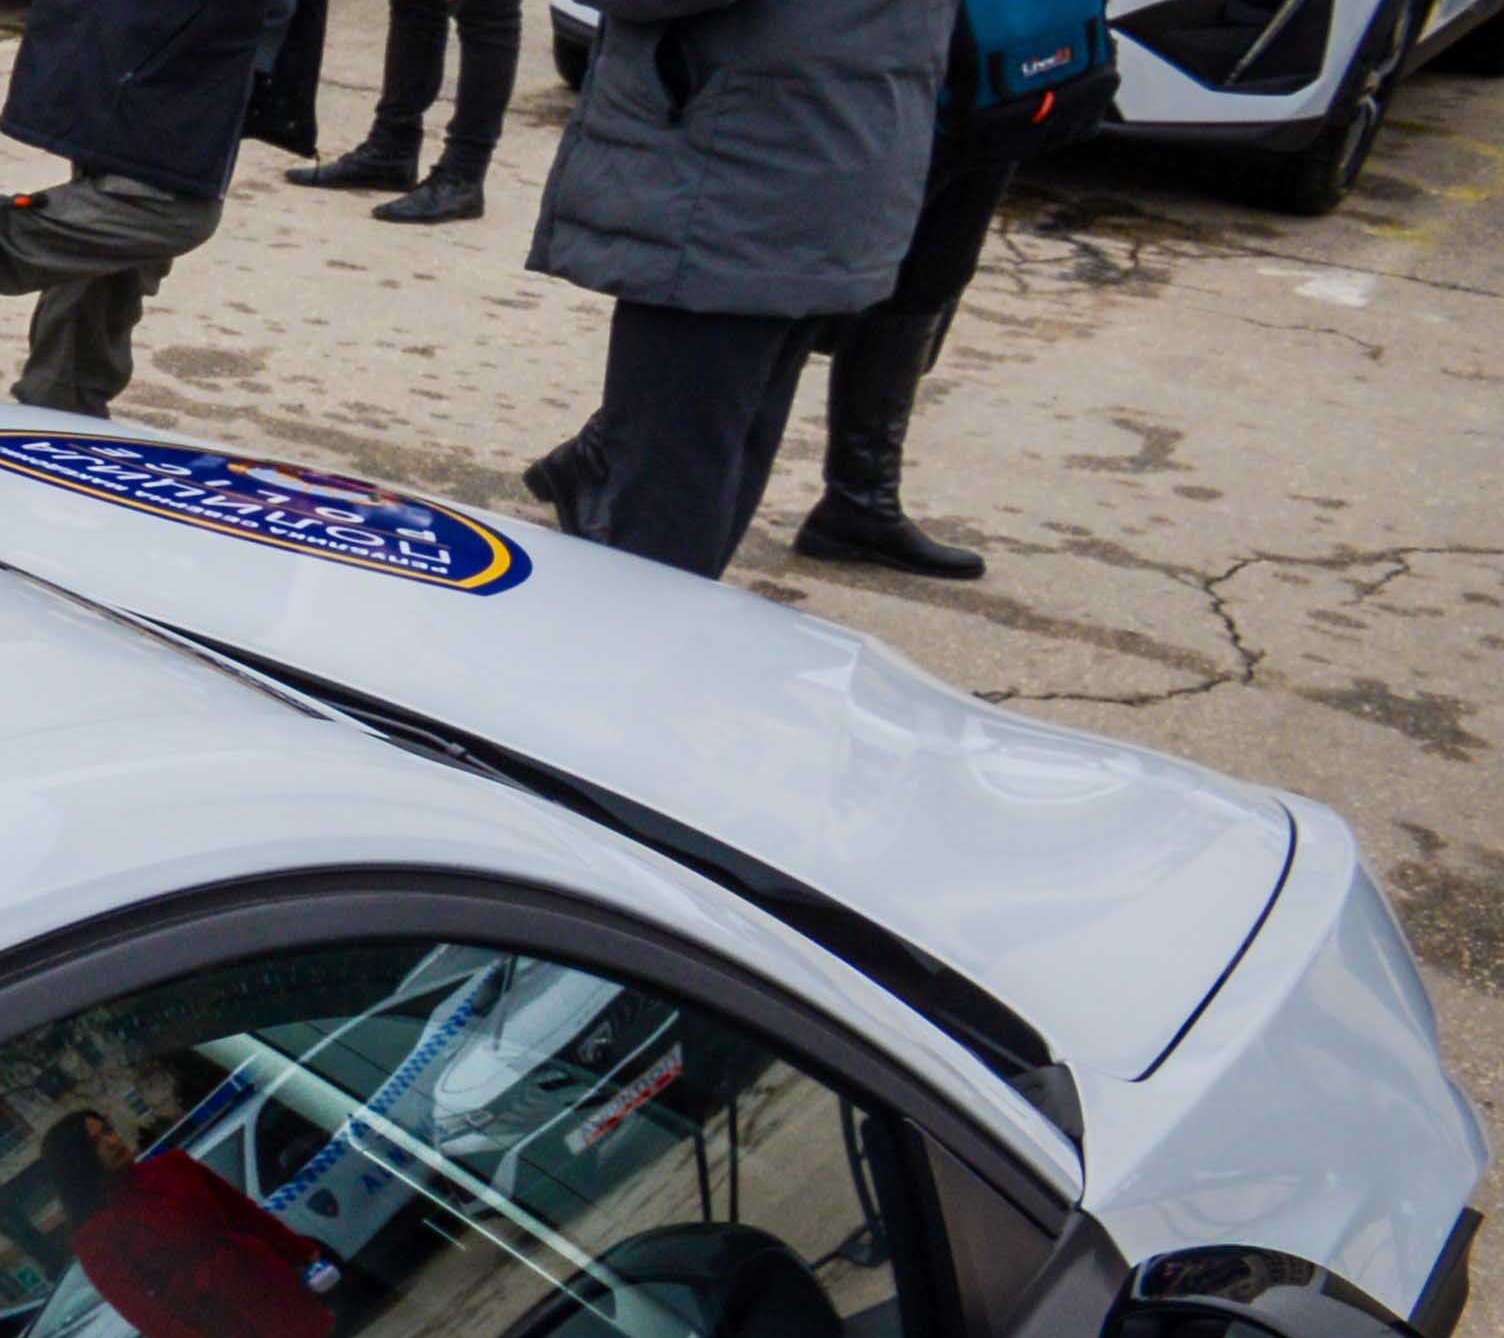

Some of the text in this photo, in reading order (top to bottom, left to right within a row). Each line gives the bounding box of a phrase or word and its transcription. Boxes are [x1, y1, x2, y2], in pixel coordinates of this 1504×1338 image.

[20, 441, 452, 565] ПОЛИЦИЈА
[90, 445, 437, 543] POLICE
[134, 489, 260, 528] СЕВЕРНА
[270, 526, 449, 575] РЕПУБЛИКА
